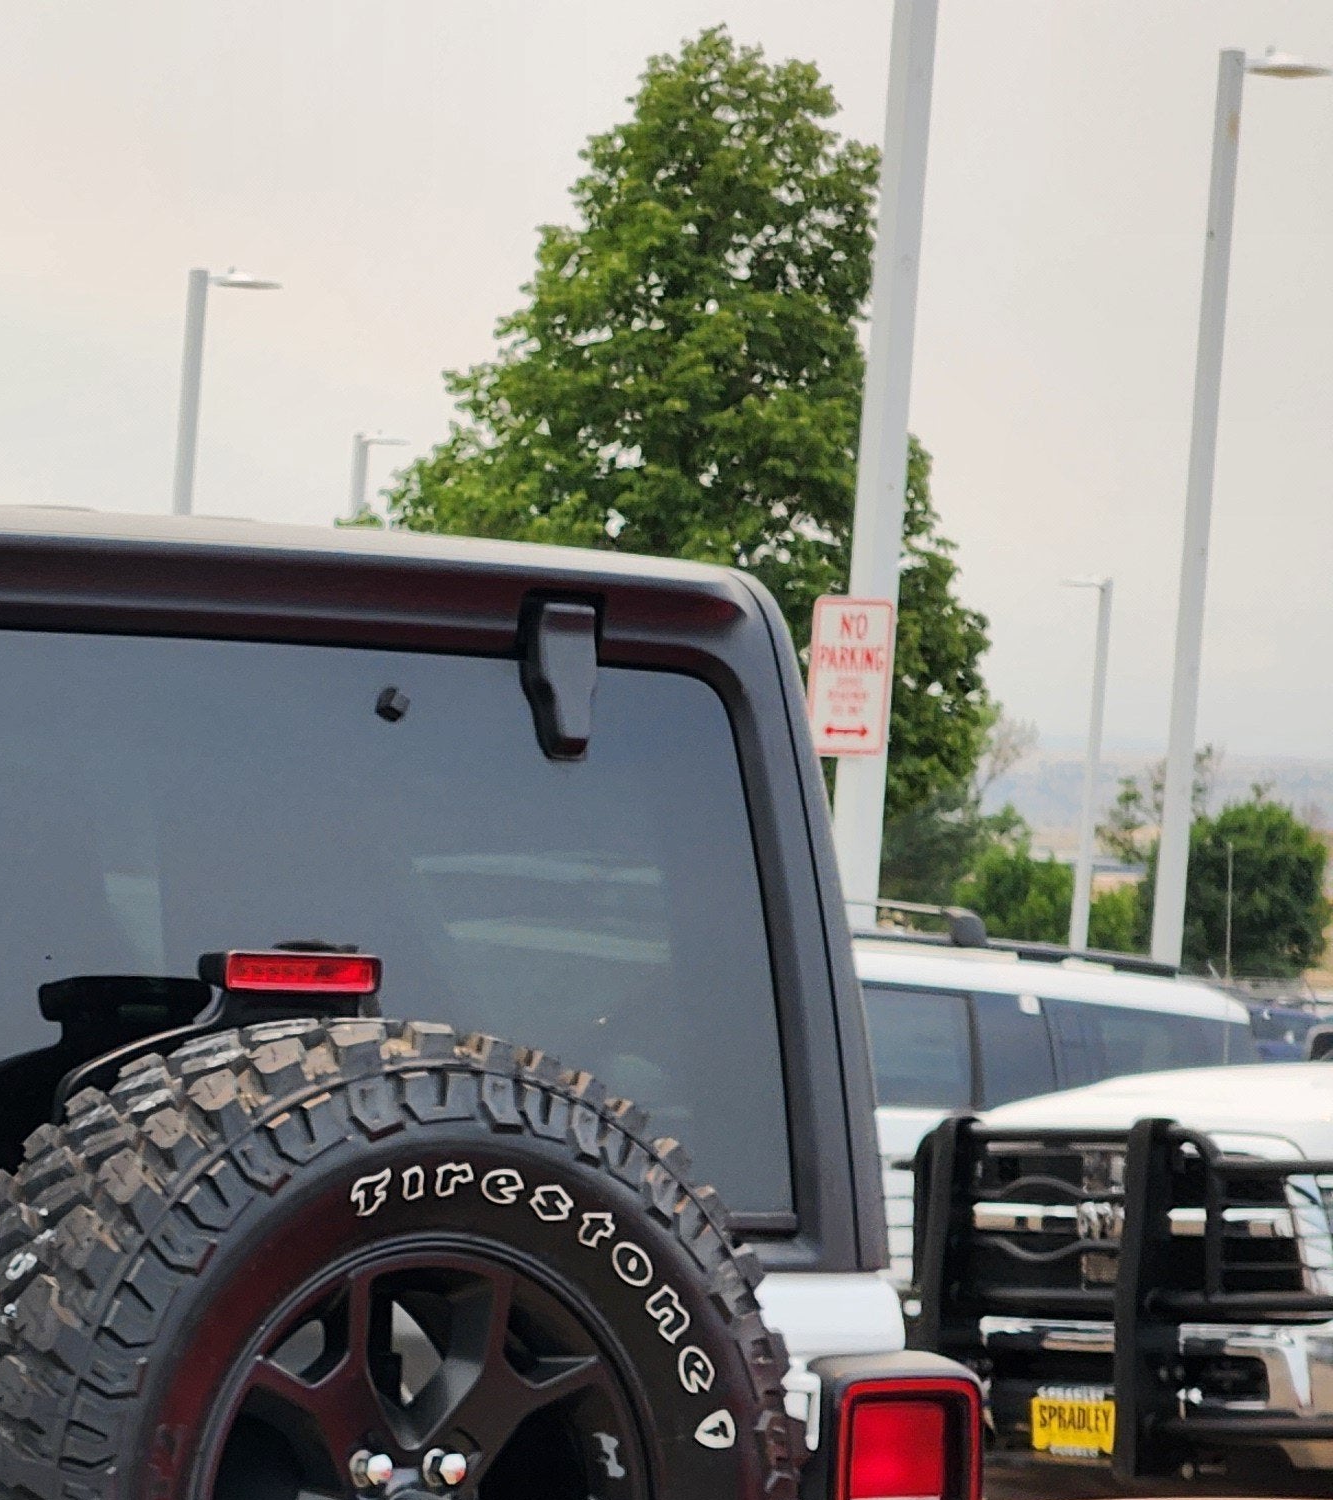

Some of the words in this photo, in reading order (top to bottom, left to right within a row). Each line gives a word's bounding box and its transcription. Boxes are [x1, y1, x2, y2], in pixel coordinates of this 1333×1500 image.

[841, 612, 869, 640] NO
[820, 646, 885, 672] PARKING
[350, 1162, 716, 1395] Firestone
[1038, 1404, 1111, 1433] SPRADLEY
